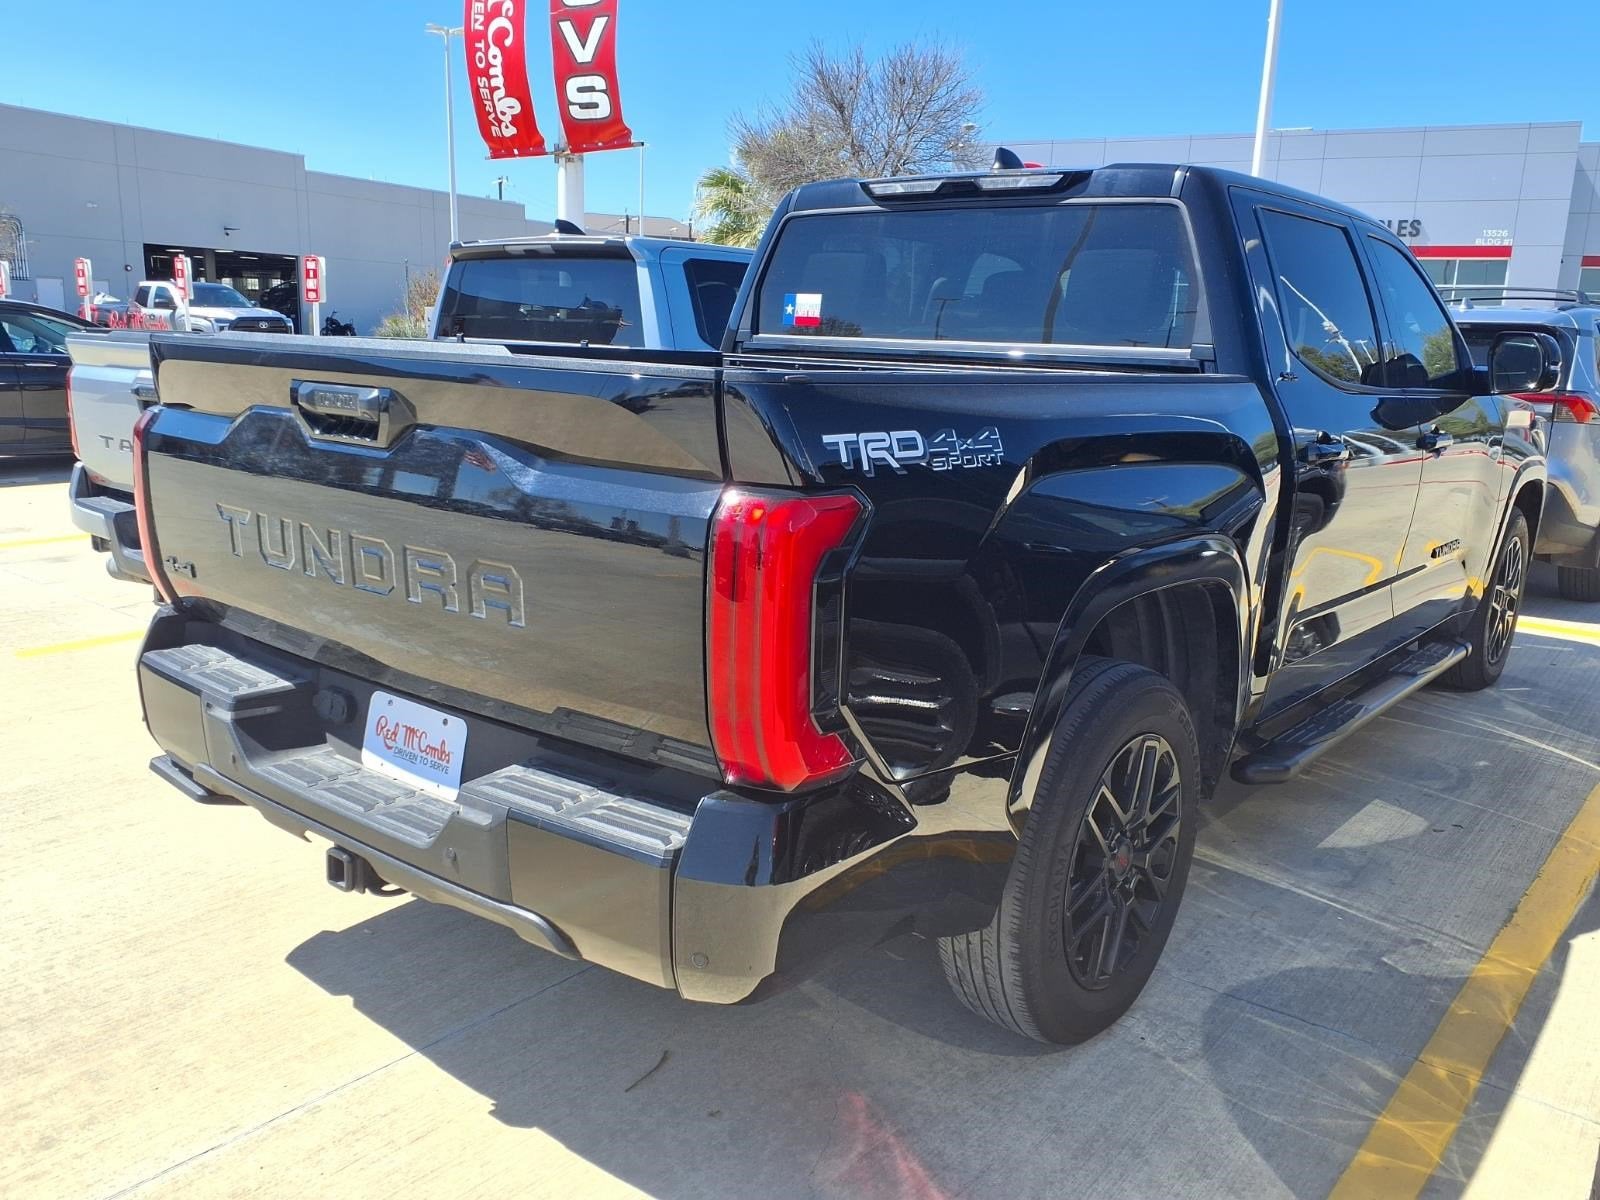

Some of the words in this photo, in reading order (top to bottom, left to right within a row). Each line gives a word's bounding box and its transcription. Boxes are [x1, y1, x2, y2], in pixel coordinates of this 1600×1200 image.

[475, 39, 486, 68] TO
[558, 0, 612, 120] VS
[478, 76, 502, 137] SERVE
[1482, 229, 1509, 238] 13526
[822, 430, 929, 477] TRD
[932, 452, 1005, 472] SPORT
[216, 502, 526, 628] TUNDRA
[376, 715, 400, 750] Red
[402, 724, 451, 764] McCombs
[393, 746, 419, 762] DRIVEN
[419, 755, 429, 766] TO
[429, 760, 450, 775] SERVE
